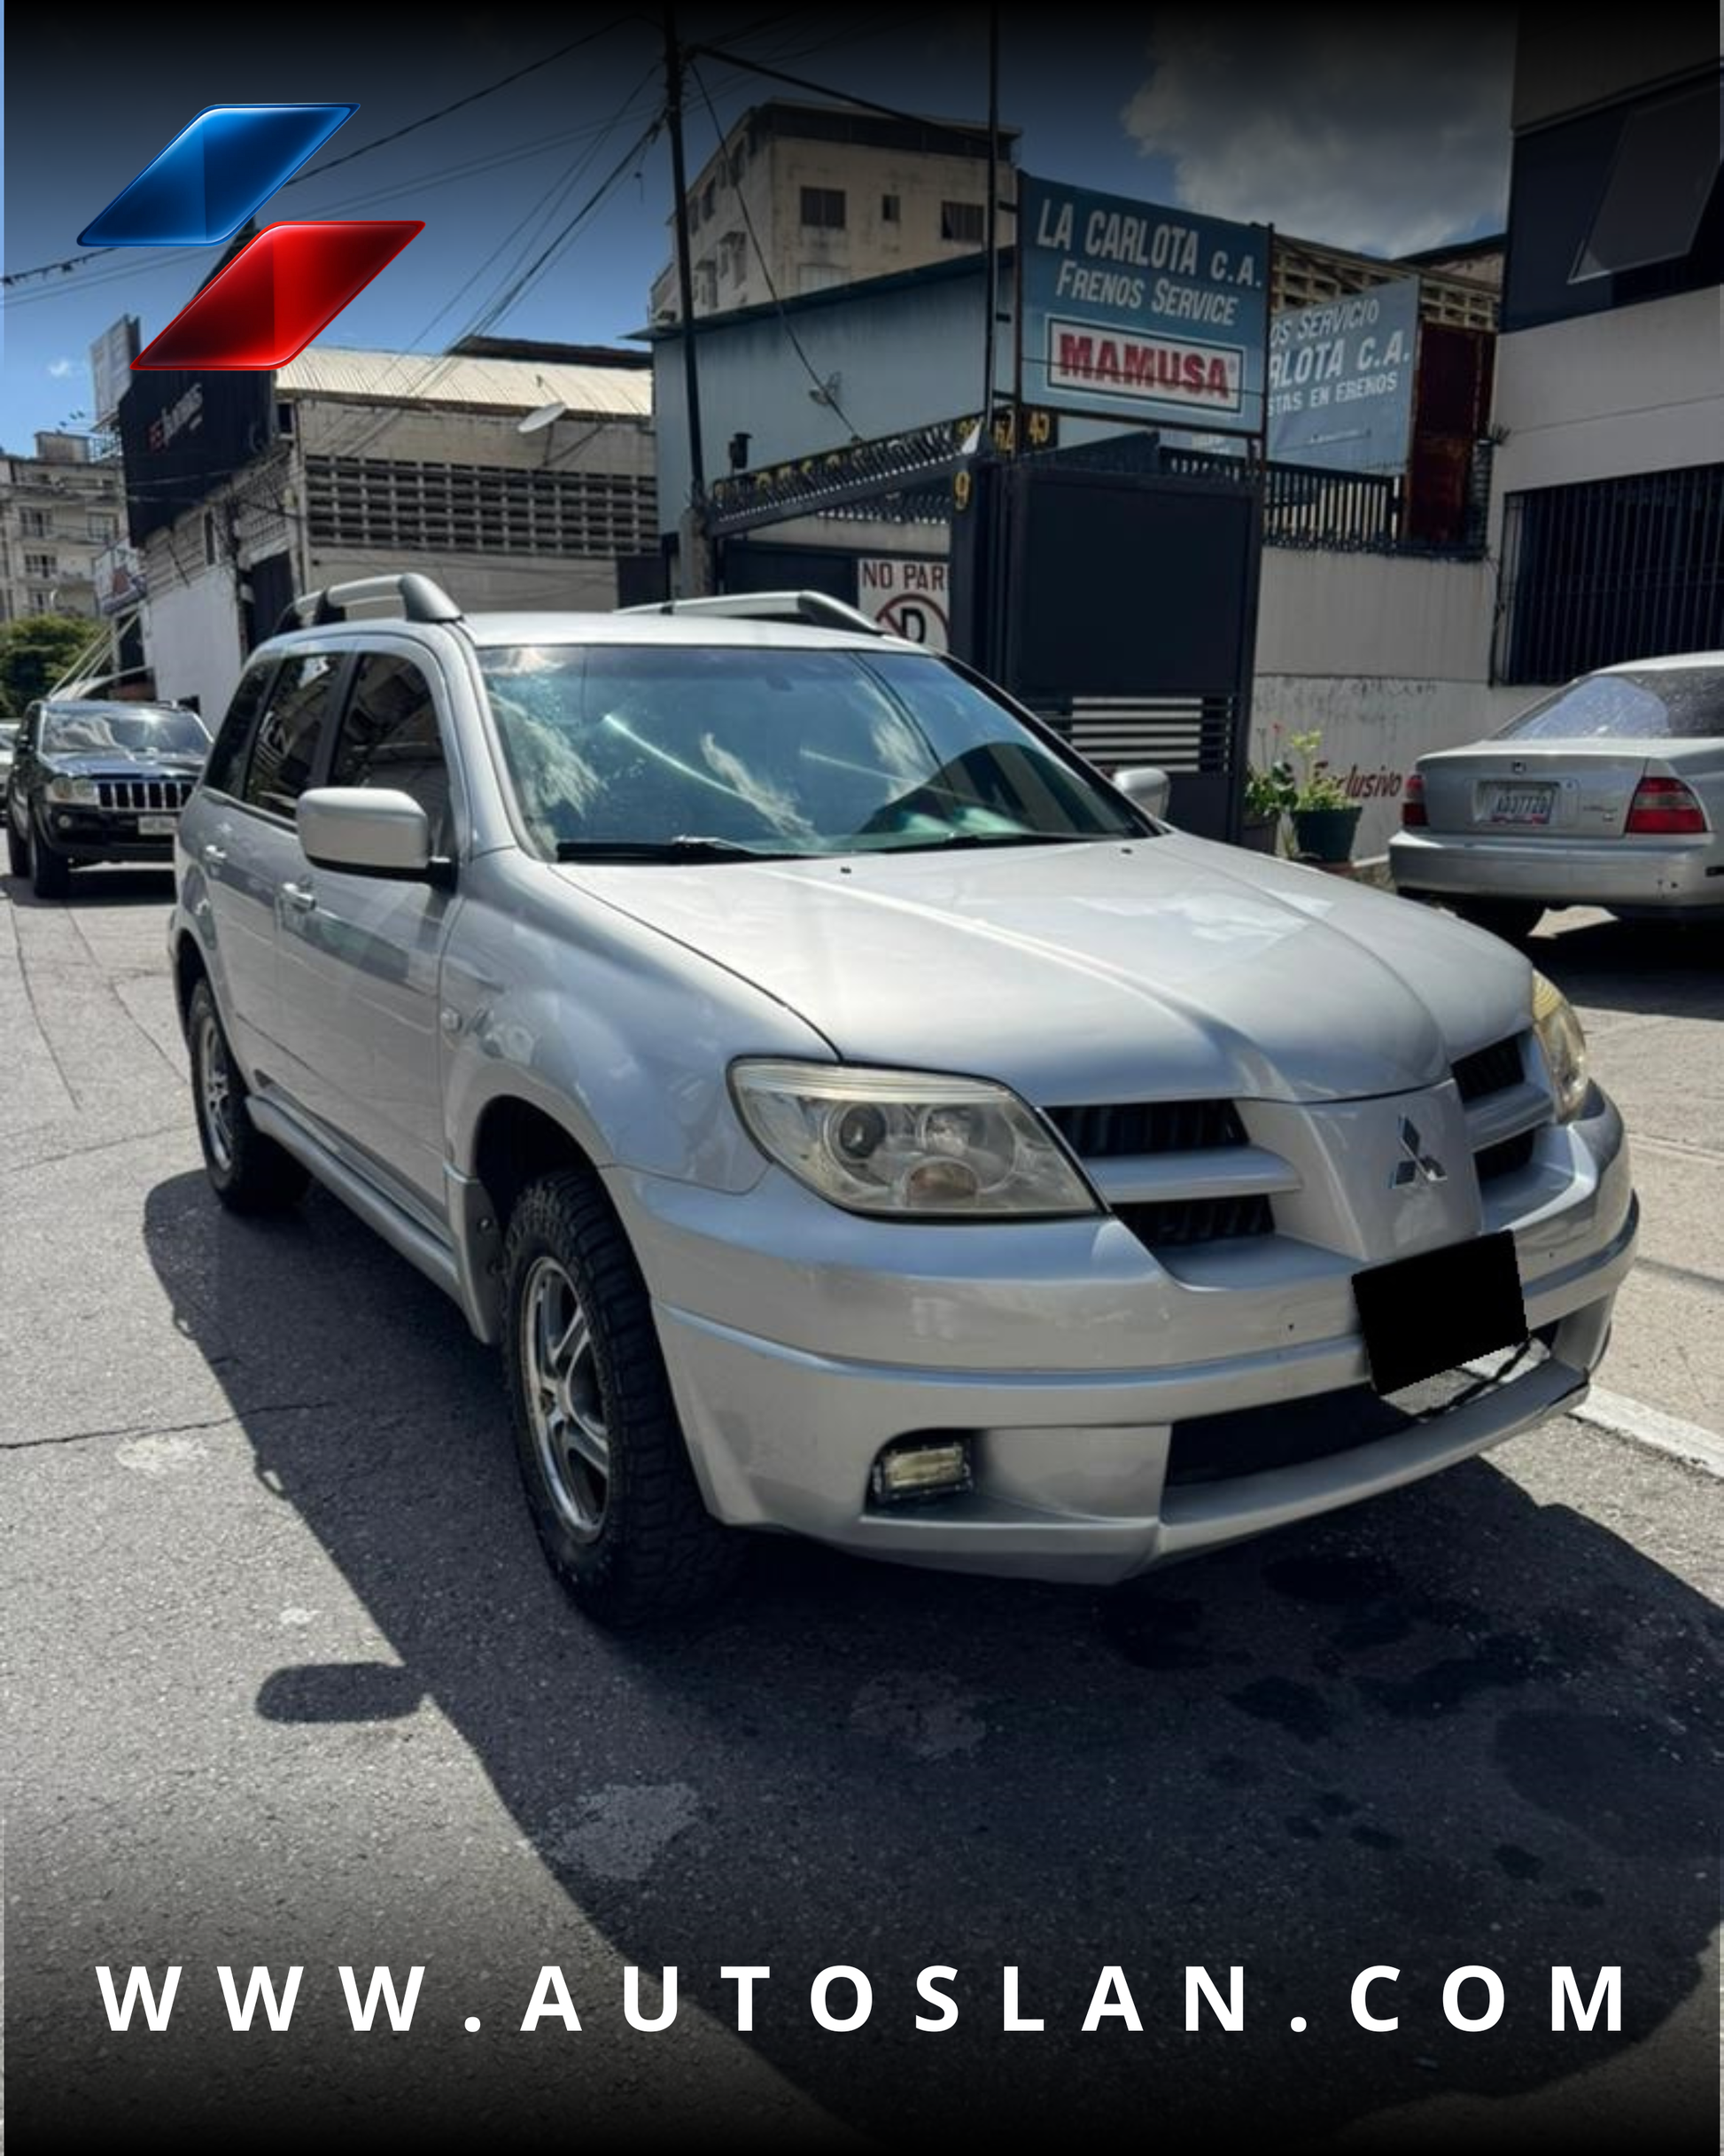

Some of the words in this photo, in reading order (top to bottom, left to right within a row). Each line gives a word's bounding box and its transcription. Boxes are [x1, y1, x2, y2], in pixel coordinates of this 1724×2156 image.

[1037, 198, 1074, 251] LA
[1084, 210, 1200, 275] CARLOTA
[1209, 250, 1262, 288] C.A.
[1055, 261, 1145, 309] FRENOS
[1152, 277, 1239, 326] SERVICE
[1296, 299, 1380, 341] SERVICIO
[1059, 333, 1230, 400] MAMUSA
[1357, 329, 1410, 371] C.A.
[861, 562, 893, 589] NO
[903, 564, 945, 591] PAR
[1311, 760, 1402, 798] Eclusivo
